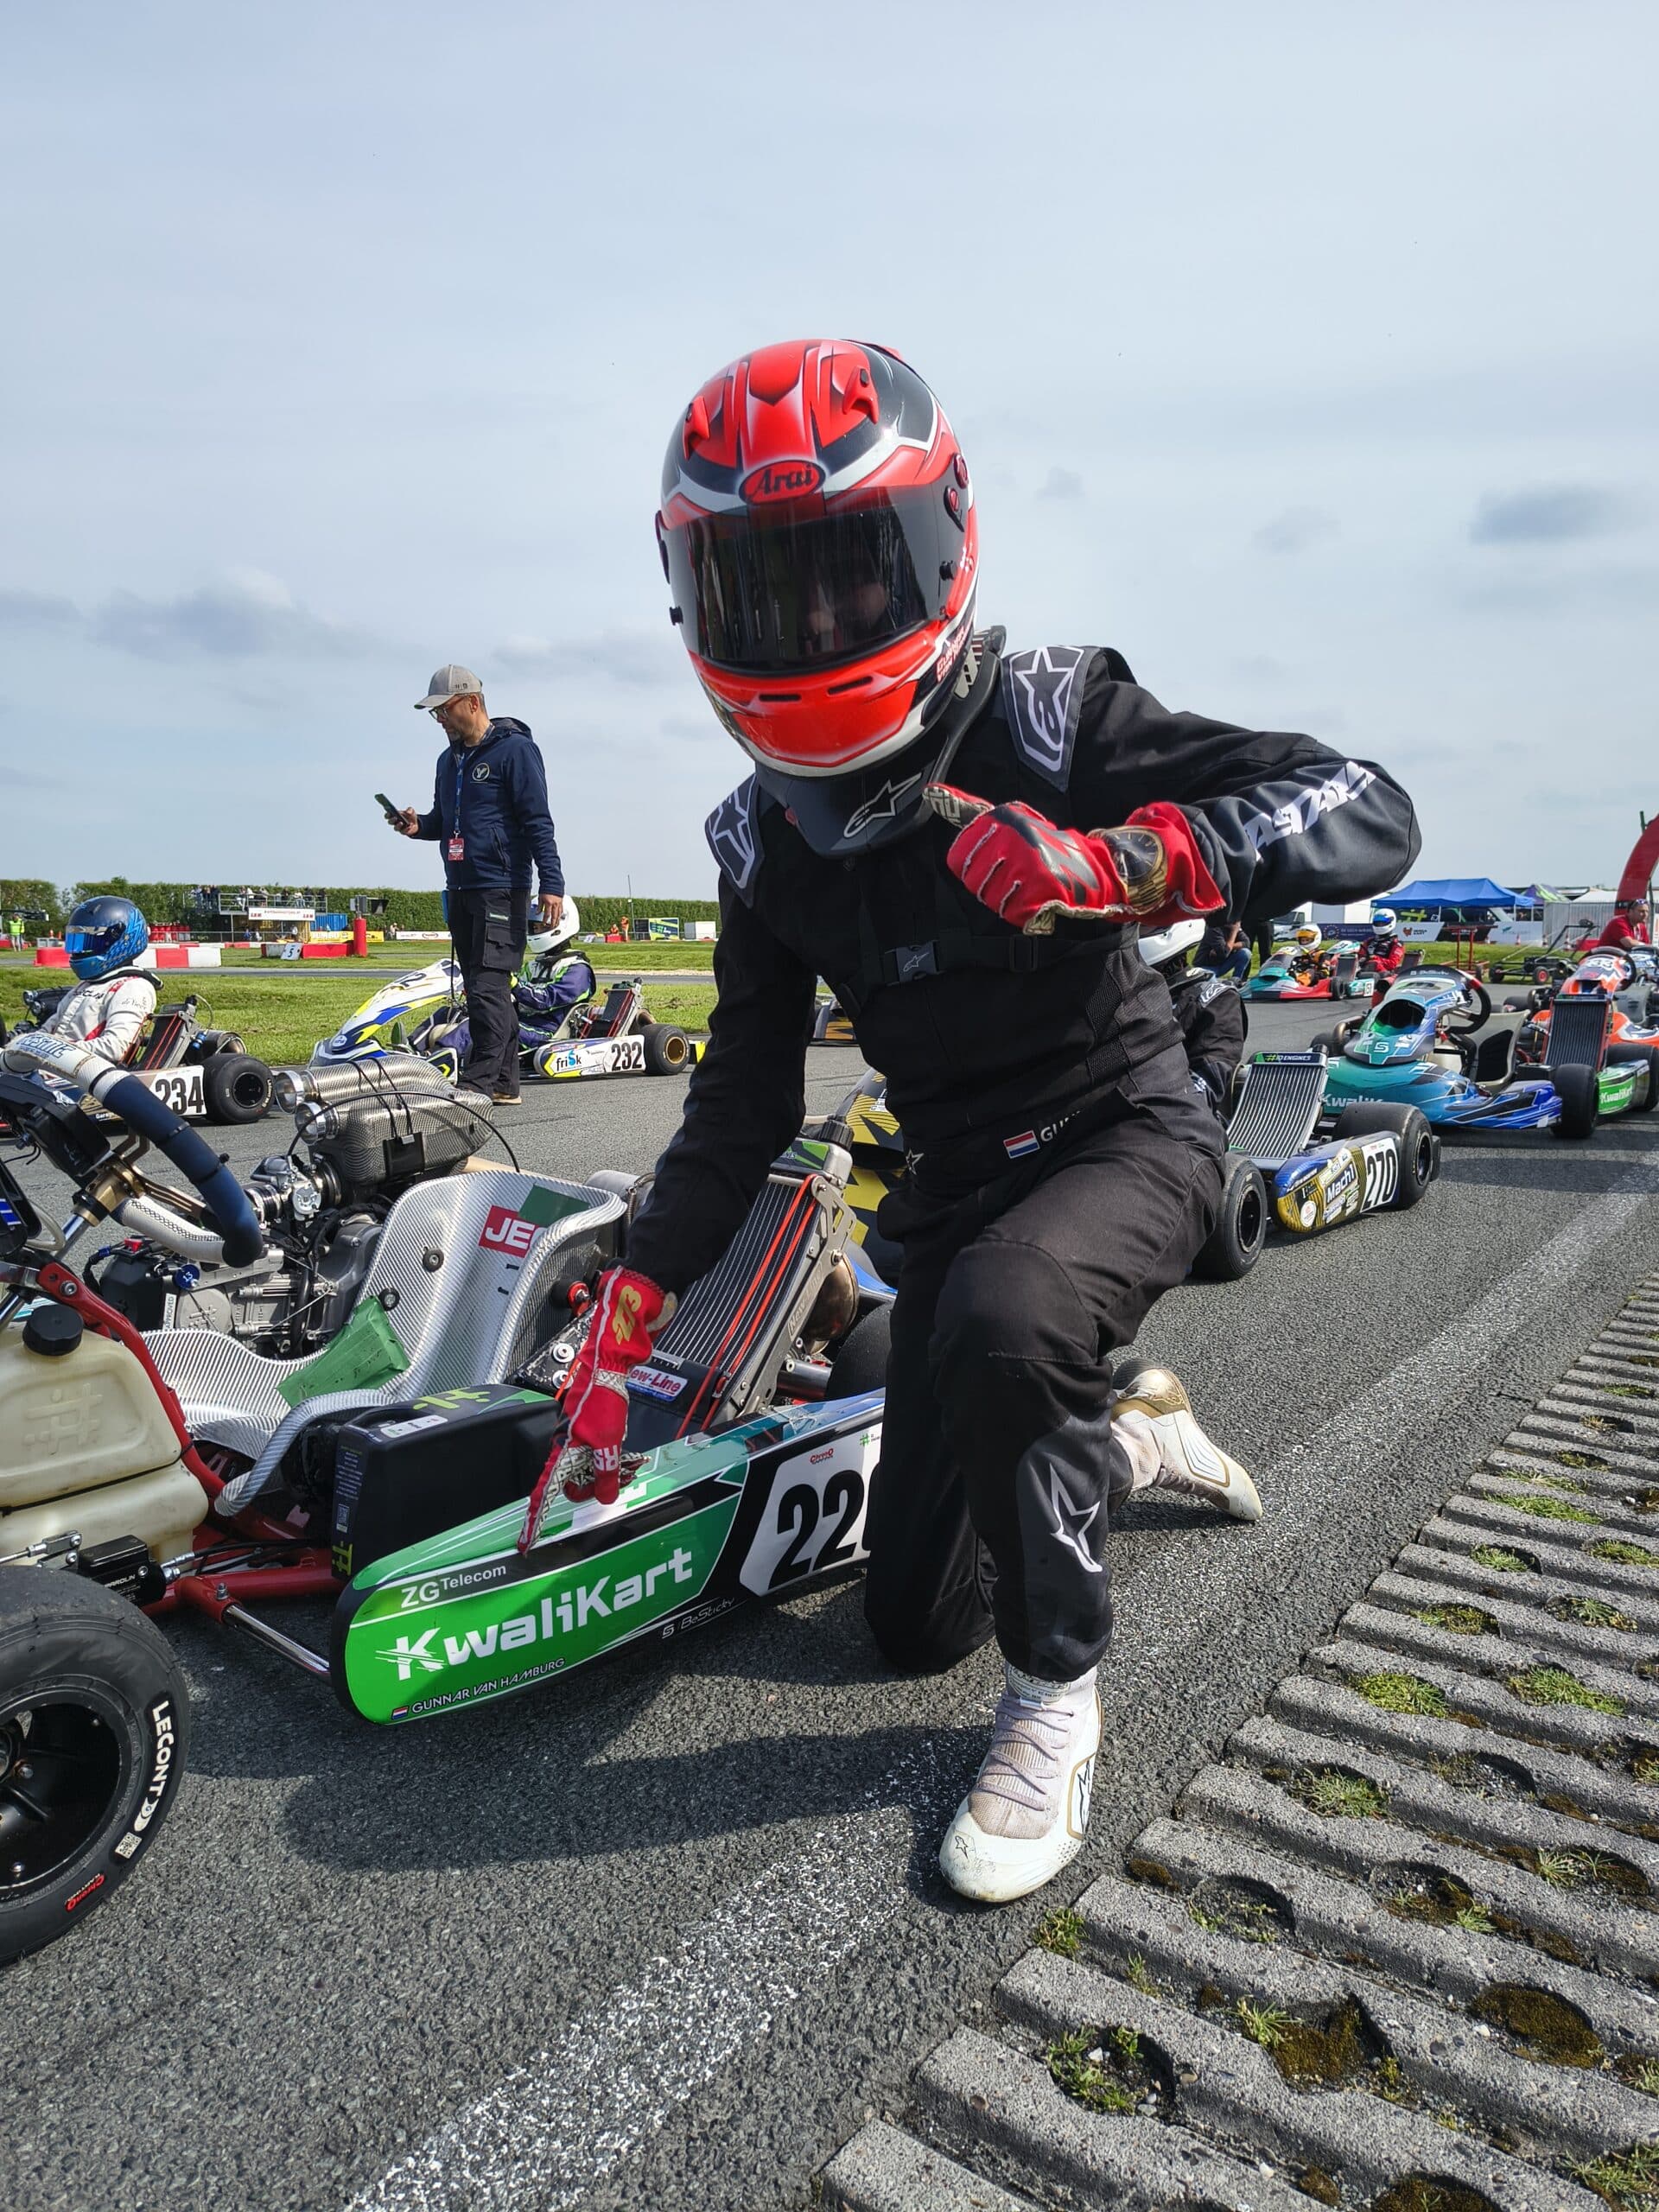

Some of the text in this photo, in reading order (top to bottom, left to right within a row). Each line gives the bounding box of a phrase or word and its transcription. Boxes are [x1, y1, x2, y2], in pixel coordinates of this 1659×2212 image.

[747, 463, 813, 501] Arai
[611, 1041, 643, 1071] 232
[155, 1076, 205, 1115] 234
[1326, 1163, 1356, 1204] Mach1
[1362, 1148, 1397, 1210] 270
[182, 1271, 194, 1283] 13
[629, 1368, 682, 1393] ew-Line
[768, 1460, 880, 1590] 22
[400, 1565, 506, 1609] ZG Telecom
[378, 1548, 692, 1681] KwaliKart
[681, 1598, 734, 1630] BeSticky
[411, 1657, 565, 1713] GUNNAR VAN HAMBURG
[149, 1700, 175, 1797] LECONT
